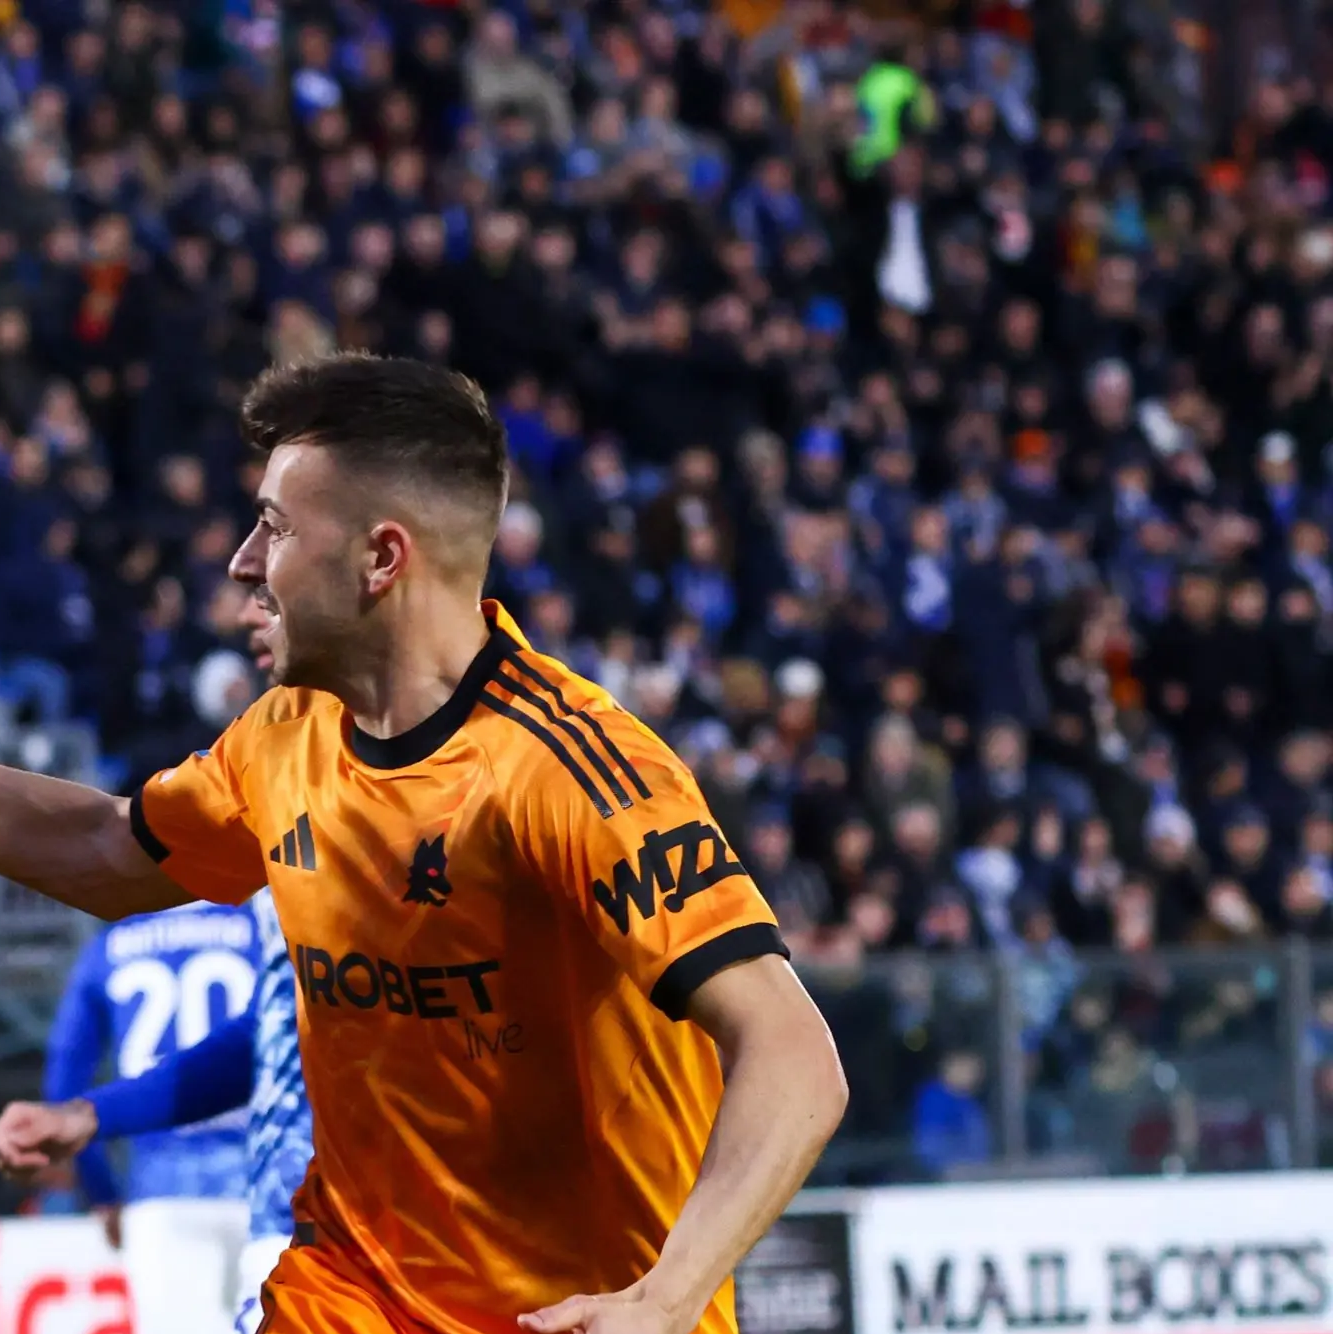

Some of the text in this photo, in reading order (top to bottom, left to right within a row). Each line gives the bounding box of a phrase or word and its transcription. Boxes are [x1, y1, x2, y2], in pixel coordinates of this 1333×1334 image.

[105, 952, 257, 1079] 20
[891, 1252, 1090, 1334] MAIL
[1105, 1237, 1329, 1324] BOXES
